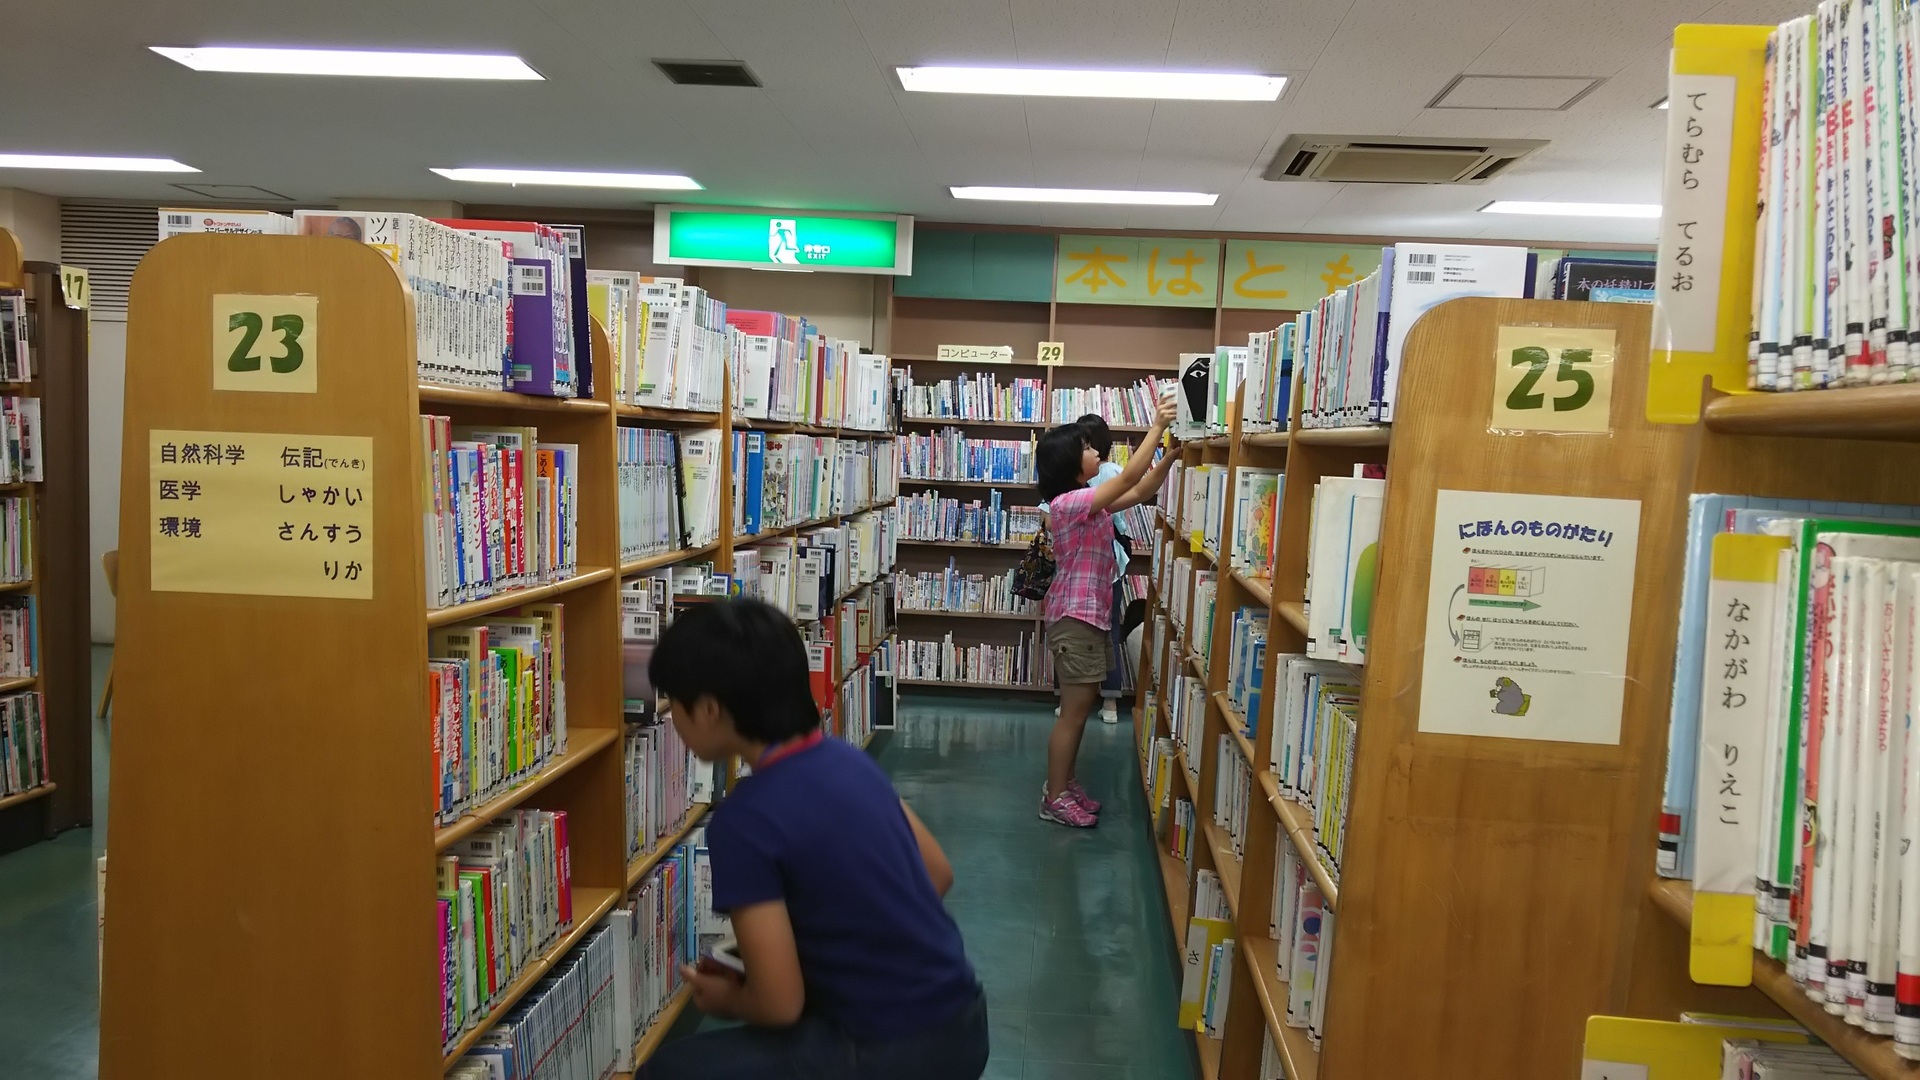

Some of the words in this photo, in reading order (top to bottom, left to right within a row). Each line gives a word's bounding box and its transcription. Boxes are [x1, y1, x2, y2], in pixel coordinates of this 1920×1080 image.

[1682, 92, 1708, 191] てらむら
[1671, 222, 1699, 292] てるお
[64, 274, 84, 301] 17
[227, 311, 305, 374] 23
[940, 348, 1009, 361] コンピューター
[1041, 346, 1061, 362] 29
[1505, 345, 1595, 413] 25
[160, 443, 246, 466] 自然科学
[280, 446, 366, 471] 伝記(でんき)
[159, 480, 202, 502] 医学
[279, 485, 364, 507] しゃかい
[1193, 491, 1205, 501] か
[159, 517, 202, 539] 環境
[278, 522, 363, 544] さんすう
[472, 493, 481, 549] エジソン
[1459, 520, 1613, 548] にほんのものがたり
[324, 560, 363, 581] りか
[1722, 598, 1751, 709] なかがわ
[1718, 743, 1742, 826] りえこ
[1187, 951, 1199, 965] さ
